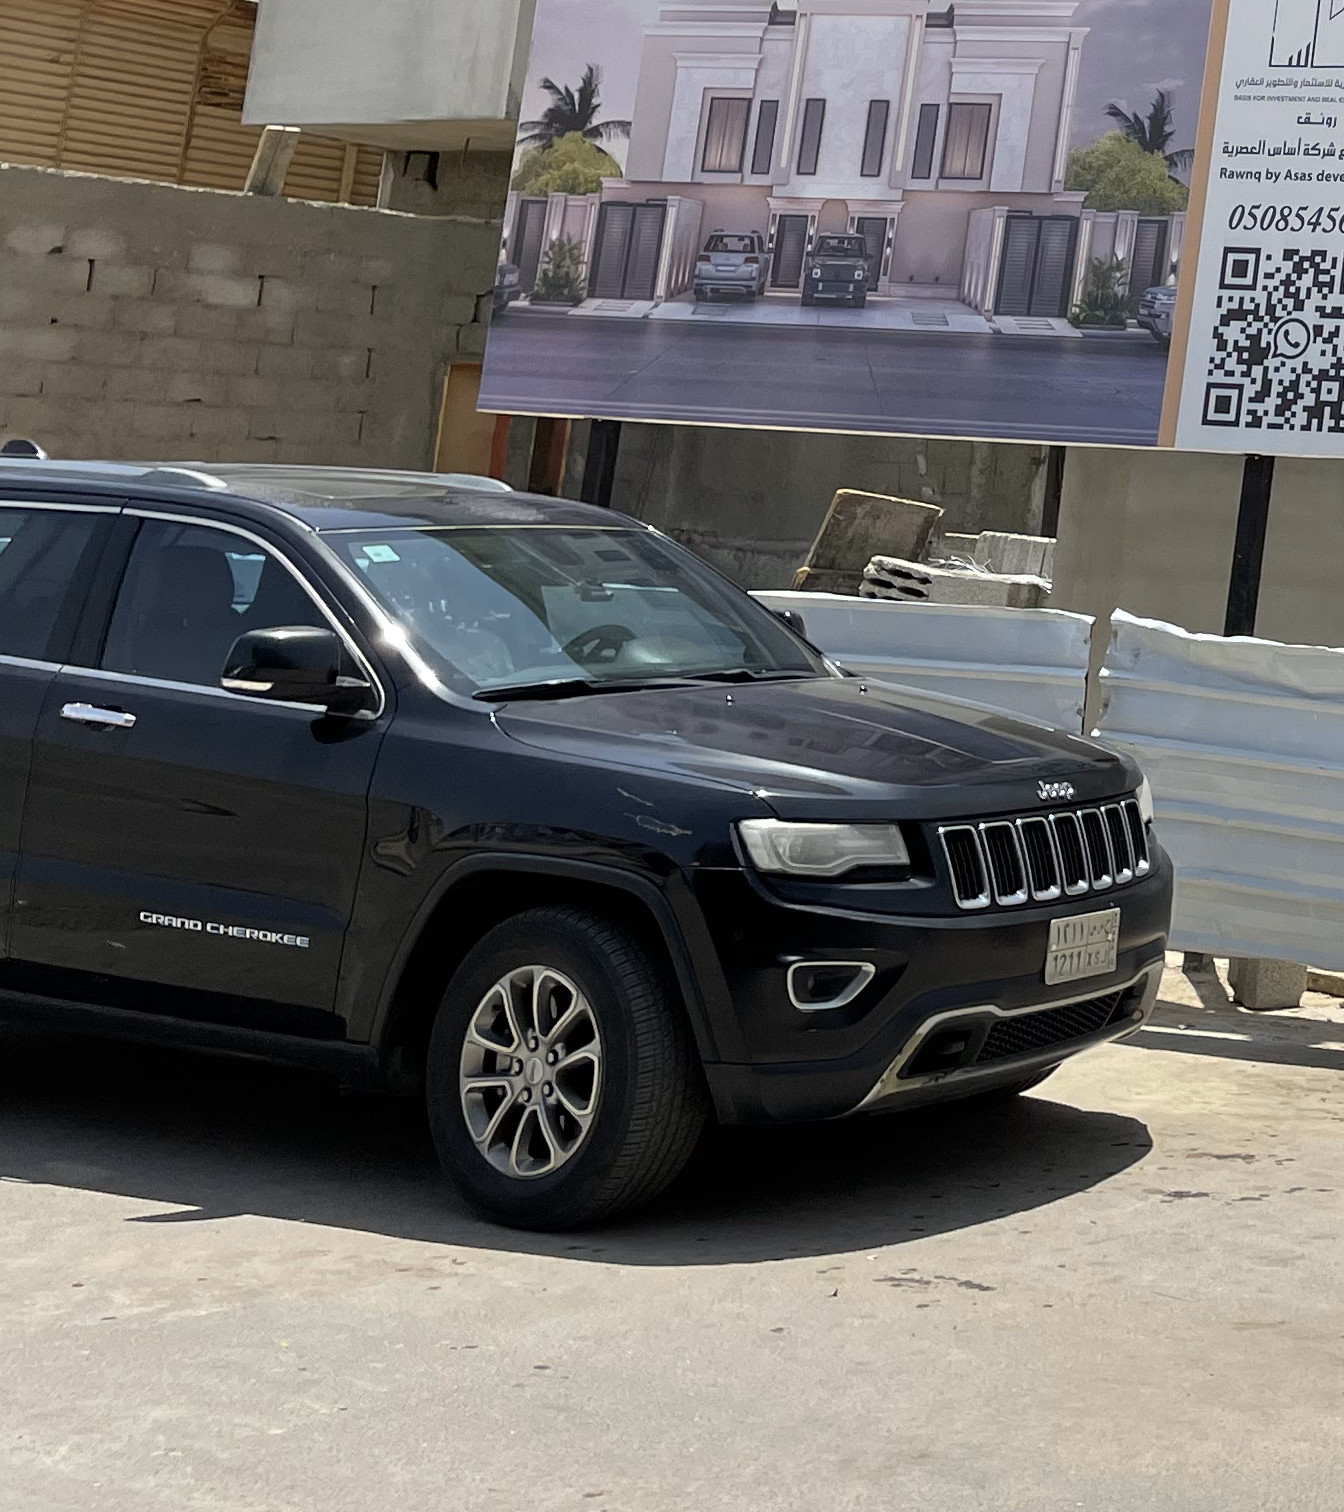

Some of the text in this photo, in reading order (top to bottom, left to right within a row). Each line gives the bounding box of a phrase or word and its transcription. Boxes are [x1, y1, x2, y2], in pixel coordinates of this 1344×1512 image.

[1235, 76, 1264, 89] العقاري
[1265, 77, 1299, 89] والتطوير
[1299, 78, 1334, 90] للاستثمار
[1222, 139, 1266, 158] العصرية
[1267, 138, 1302, 157] أساس
[1302, 141, 1337, 160] شركة
[1219, 167, 1262, 183] Rawnq
[1265, 168, 1281, 184] by
[1284, 169, 1313, 182] Asas
[1037, 780, 1074, 800] Jeep
[139, 911, 310, 948] GRAND CHEROKEE
[1053, 950, 1082, 976] 1211
